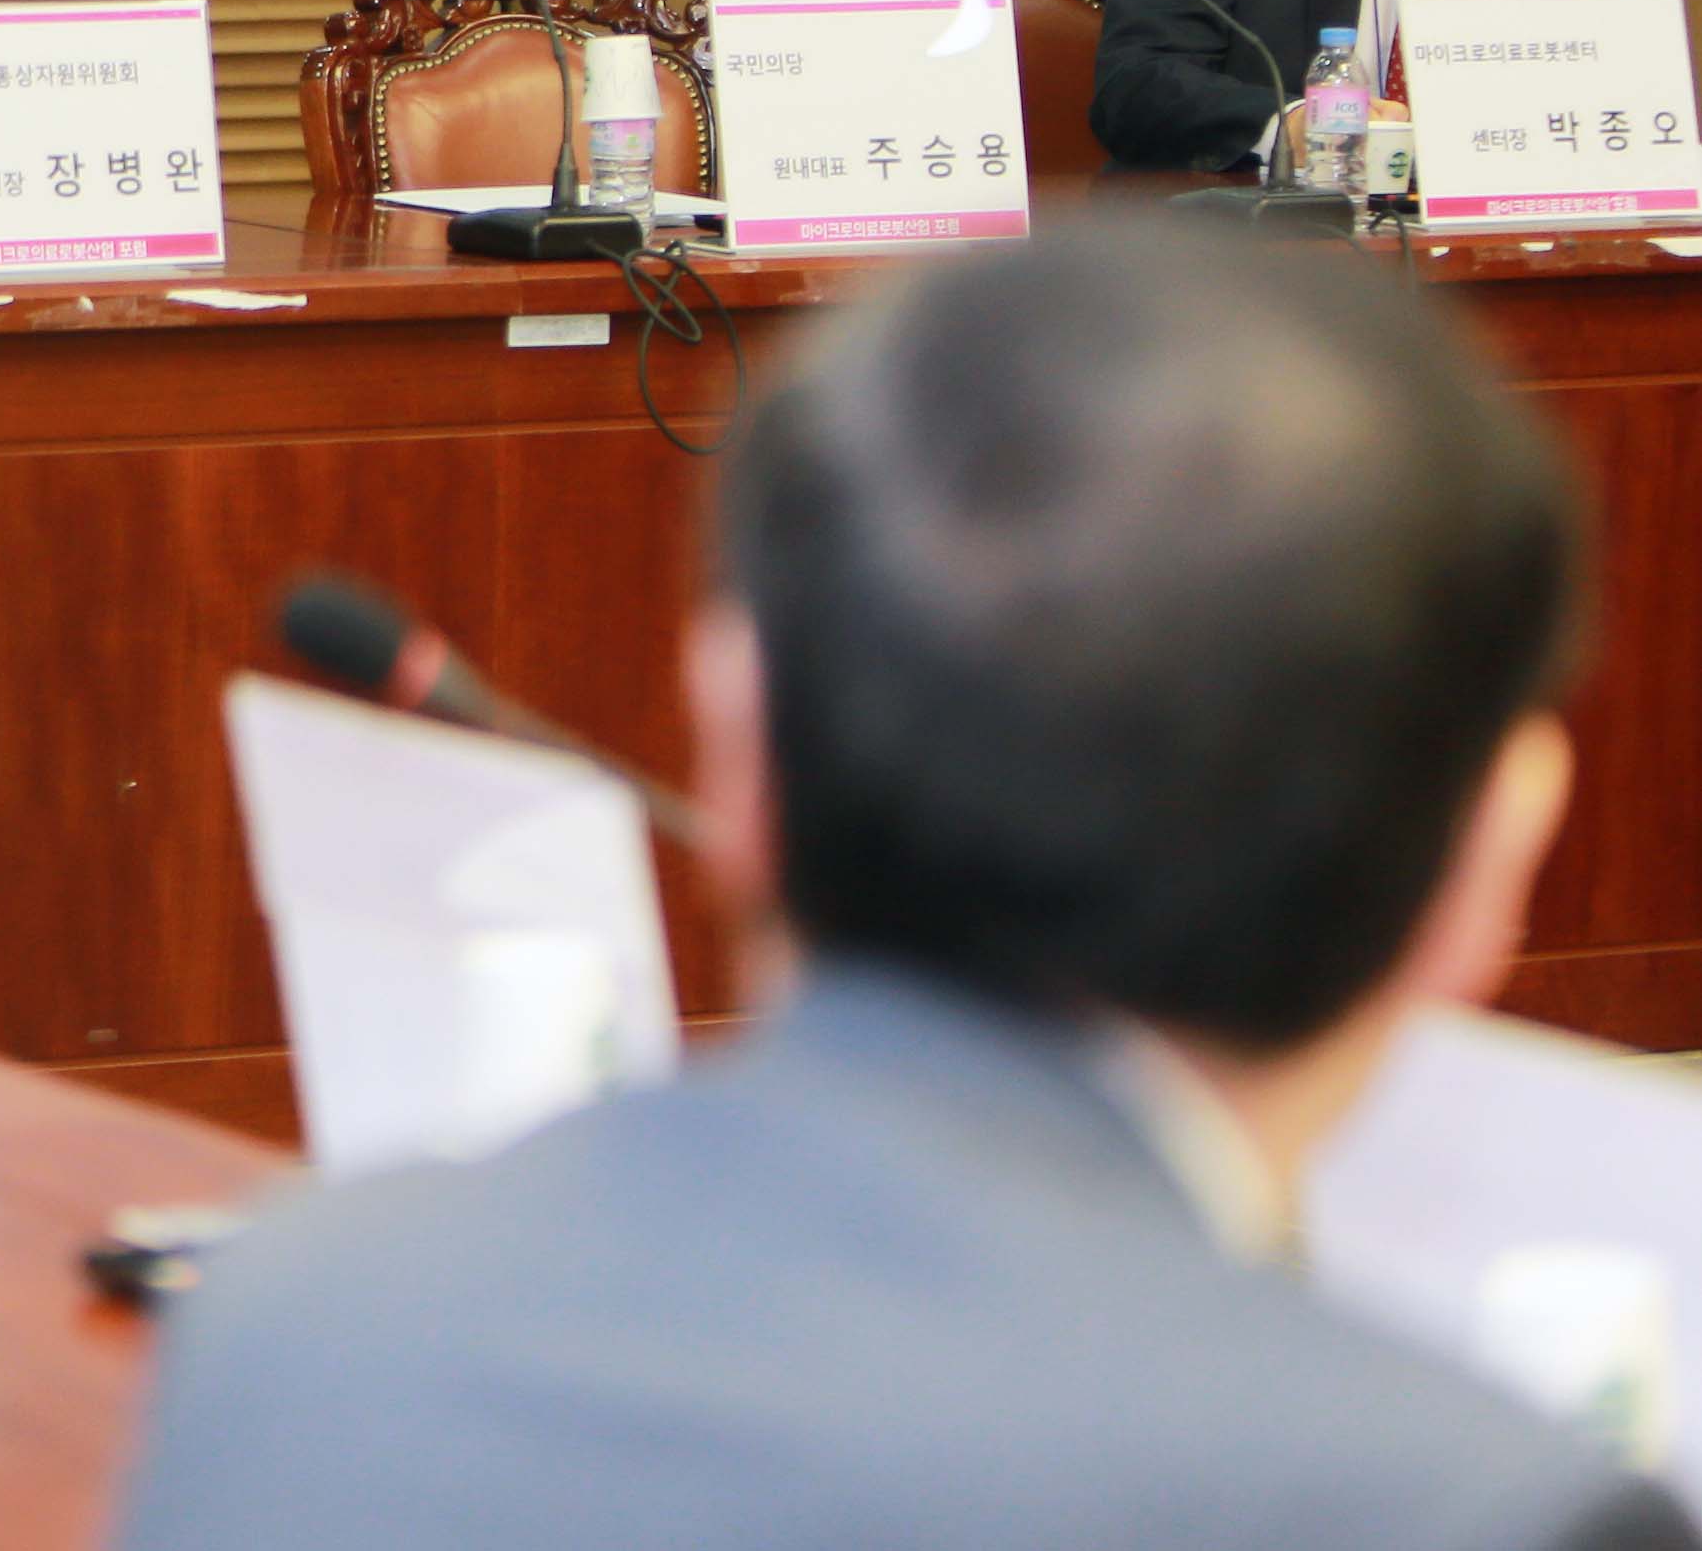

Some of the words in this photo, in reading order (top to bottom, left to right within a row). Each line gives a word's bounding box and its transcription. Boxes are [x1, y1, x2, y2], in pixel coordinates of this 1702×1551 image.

[726, 52, 804, 76] 국민의당
[1414, 40, 1598, 65] 마이크로의료로봇센터
[1471, 129, 1527, 152] 센터장
[1547, 110, 1684, 153] 박종오
[46, 147, 203, 198] 장병완
[773, 156, 848, 180] 원내대표
[867, 133, 1011, 181] 주승용
[800, 218, 930, 239] 마이크로의료로봇산업
[934, 217, 960, 236] 포럼
